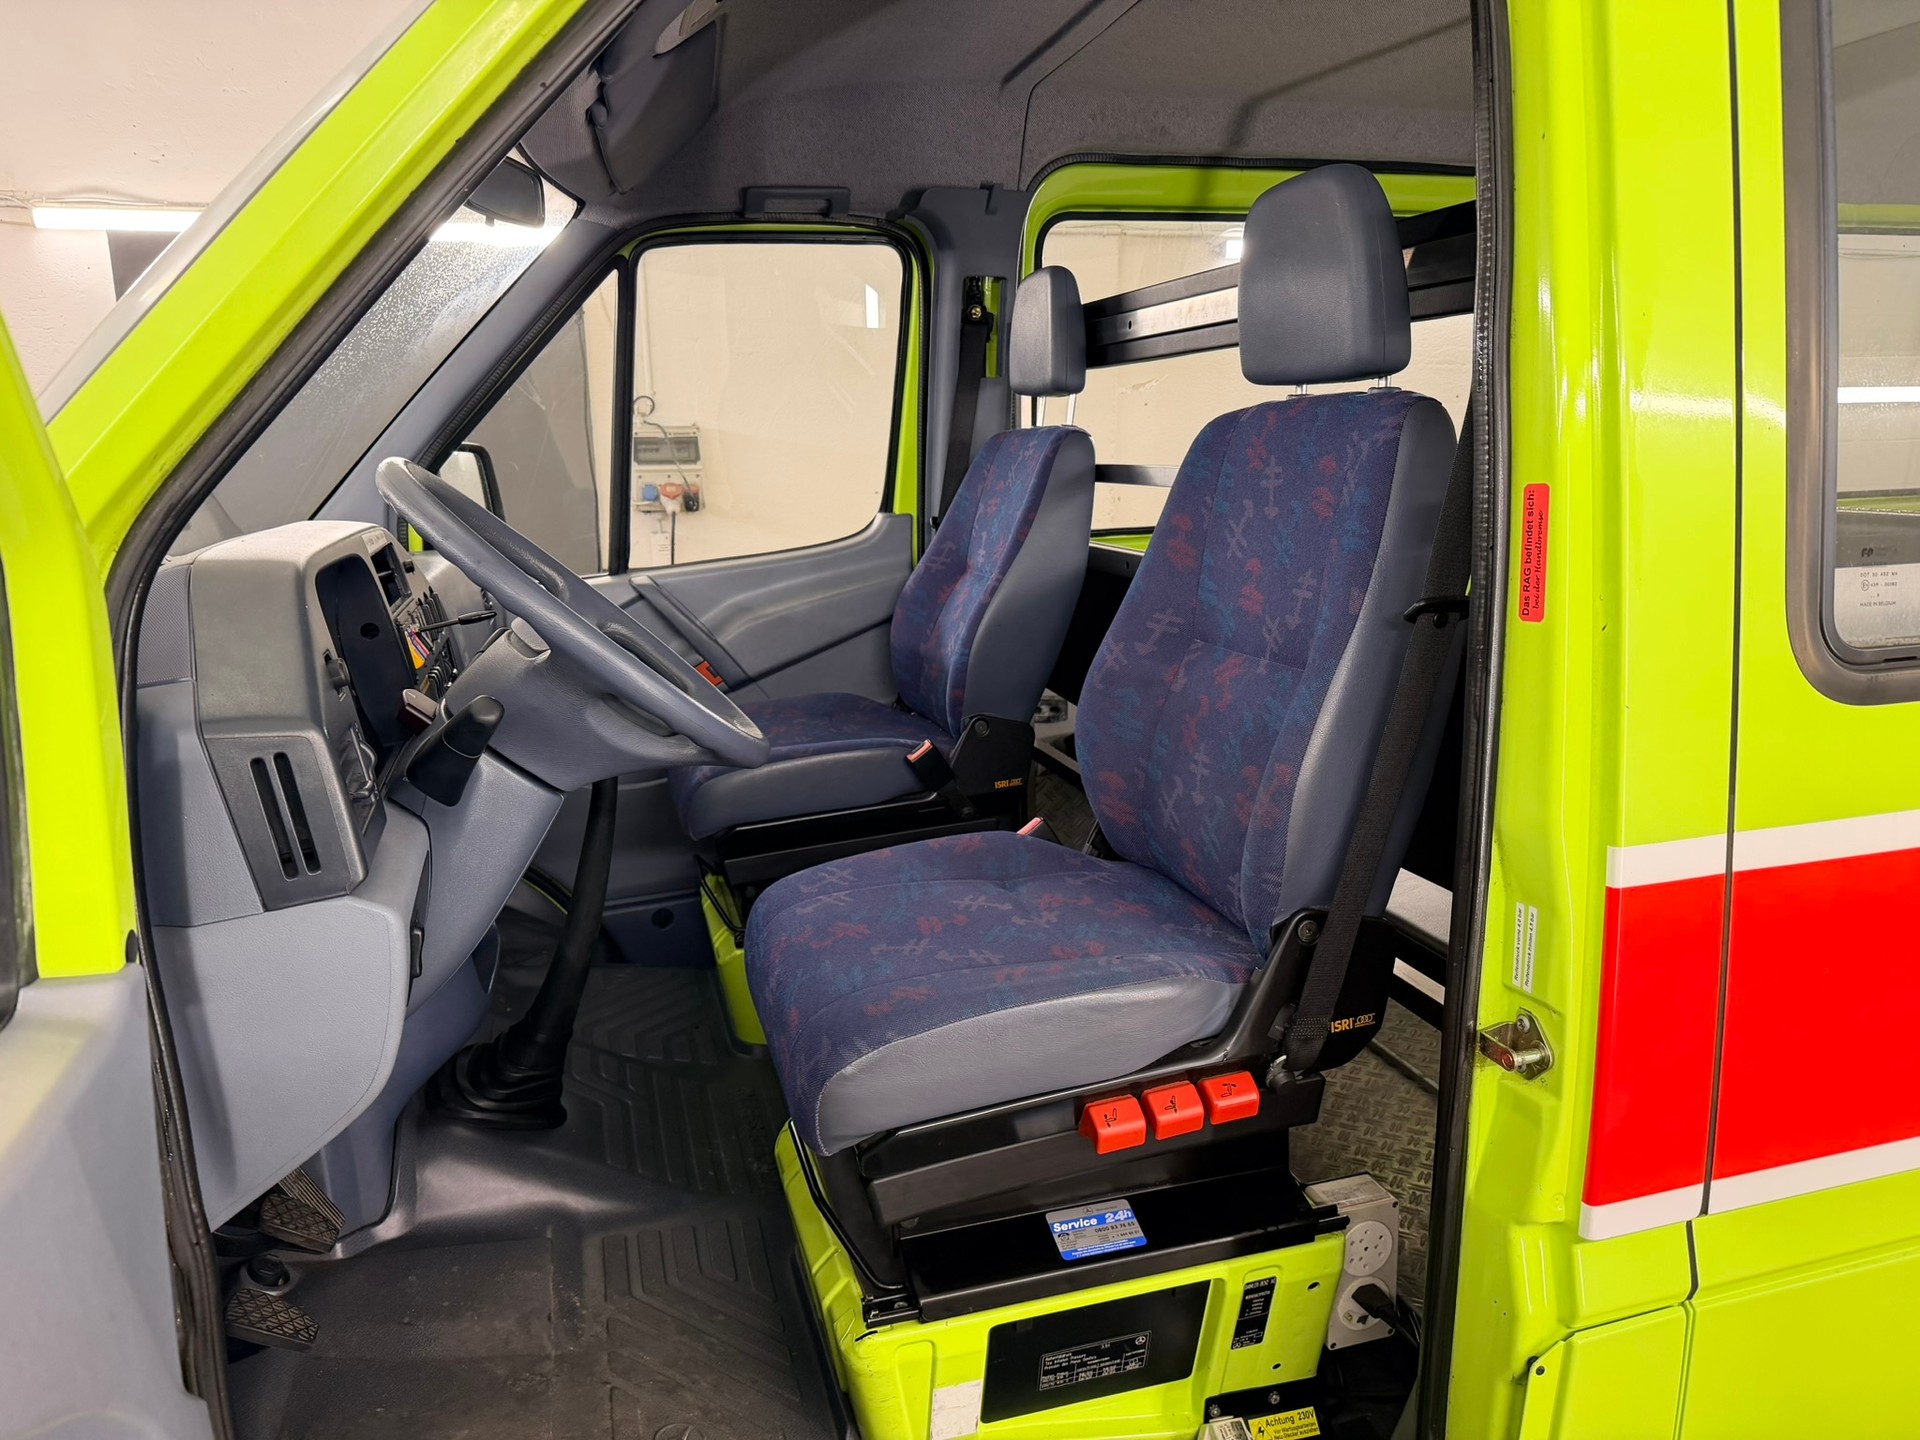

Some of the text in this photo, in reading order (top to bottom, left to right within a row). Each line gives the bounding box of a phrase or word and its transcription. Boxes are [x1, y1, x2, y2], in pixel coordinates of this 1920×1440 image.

[1534, 510, 1544, 573] Handbremse
[1521, 490, 1535, 617] Das RAG befindet sich:
[1533, 575, 1541, 593] der
[1053, 1210, 1131, 1232] Service 24h
[1265, 1410, 1314, 1428] Achtung 230V
